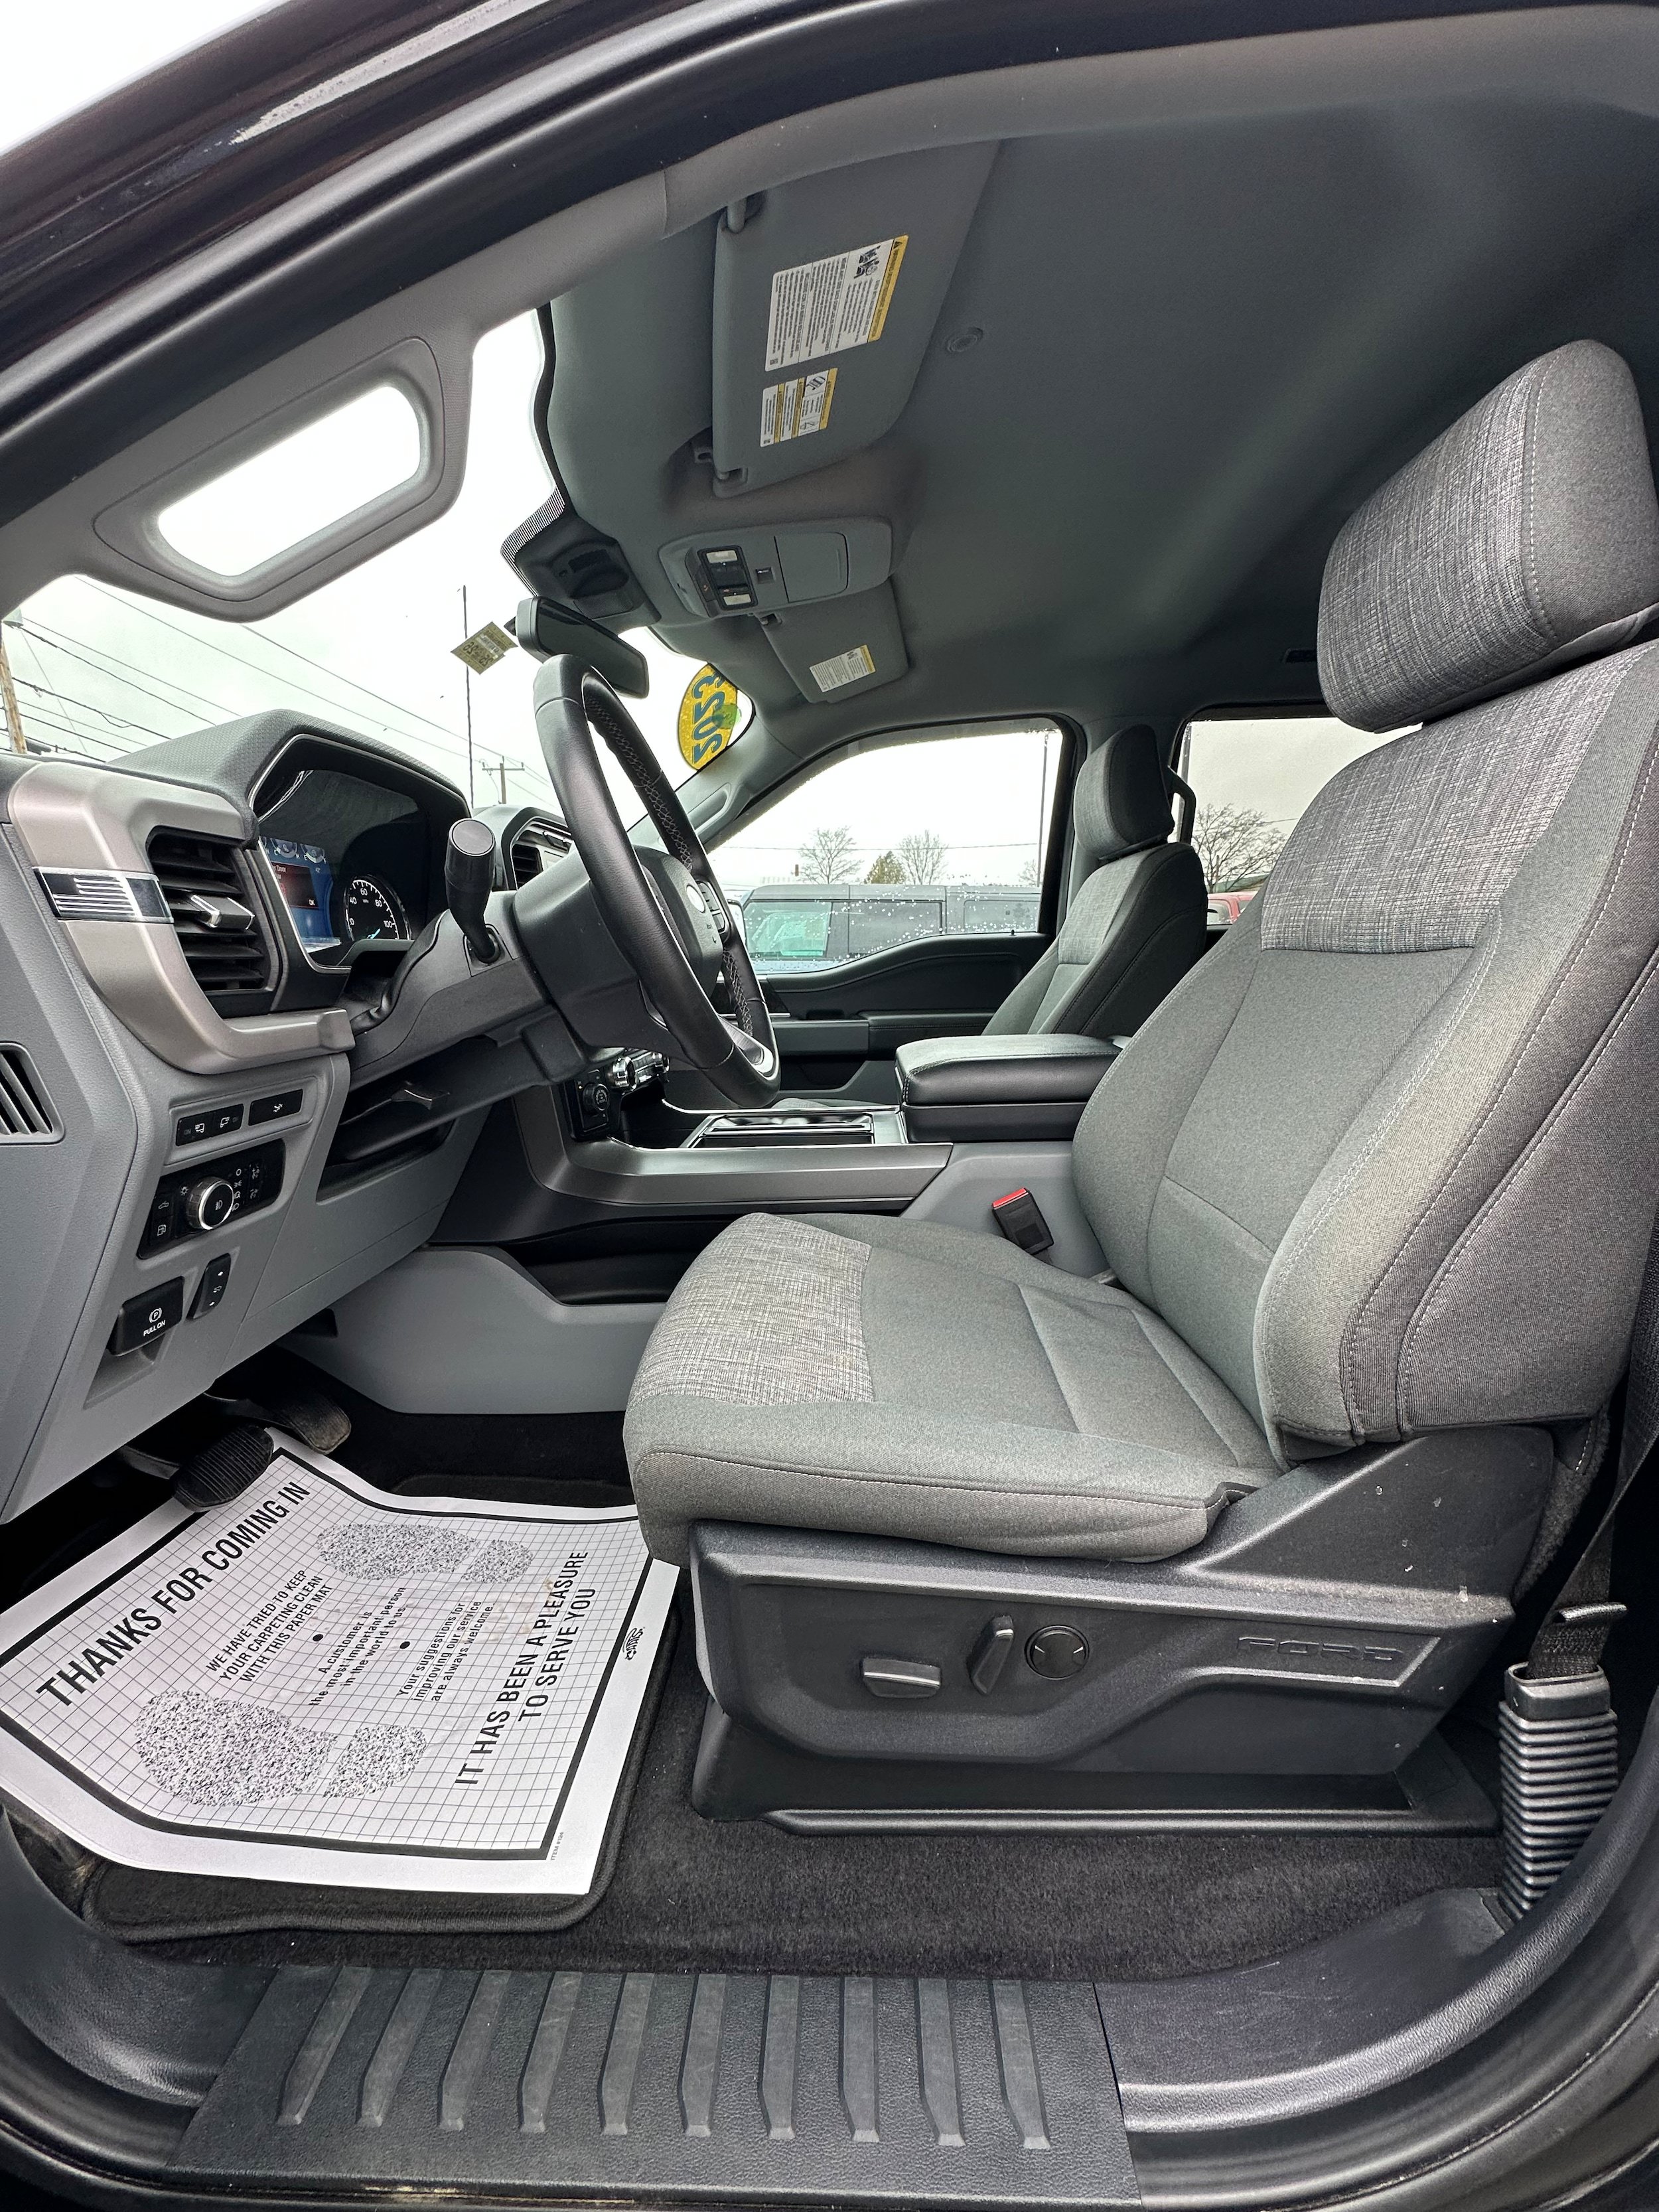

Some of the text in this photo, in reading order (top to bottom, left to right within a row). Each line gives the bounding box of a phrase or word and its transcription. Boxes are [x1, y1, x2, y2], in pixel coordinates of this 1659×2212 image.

[143, 1319, 166, 1337] PULL ON
[36, 1481, 311, 1706] THANKS FOR COMING IN
[206, 1570, 307, 1672] WE HAVE TRIED TO KEEP
[220, 1576, 323, 1680] YOUR CARPETING CLEAN
[240, 1584, 332, 1682] WITH THIS PAPER MAT
[330, 1621, 364, 1664] customer
[309, 1587, 406, 1706] the most important person
[340, 1677, 356, 1686] in
[350, 1660, 368, 1674] the
[365, 1631, 390, 1657] world
[384, 1619, 397, 1628] to
[397, 1603, 465, 1696] Your suggestions for
[411, 1601, 482, 1701] improving our service
[431, 1603, 496, 1701] are always welcome.
[455, 1552, 589, 1785] IT HAS BEEN A PLEASURE
[518, 1588, 596, 1722] TO SERVE YOU
[1236, 1637, 1404, 1660] FORD
[551, 1846, 559, 1860] ITEM
